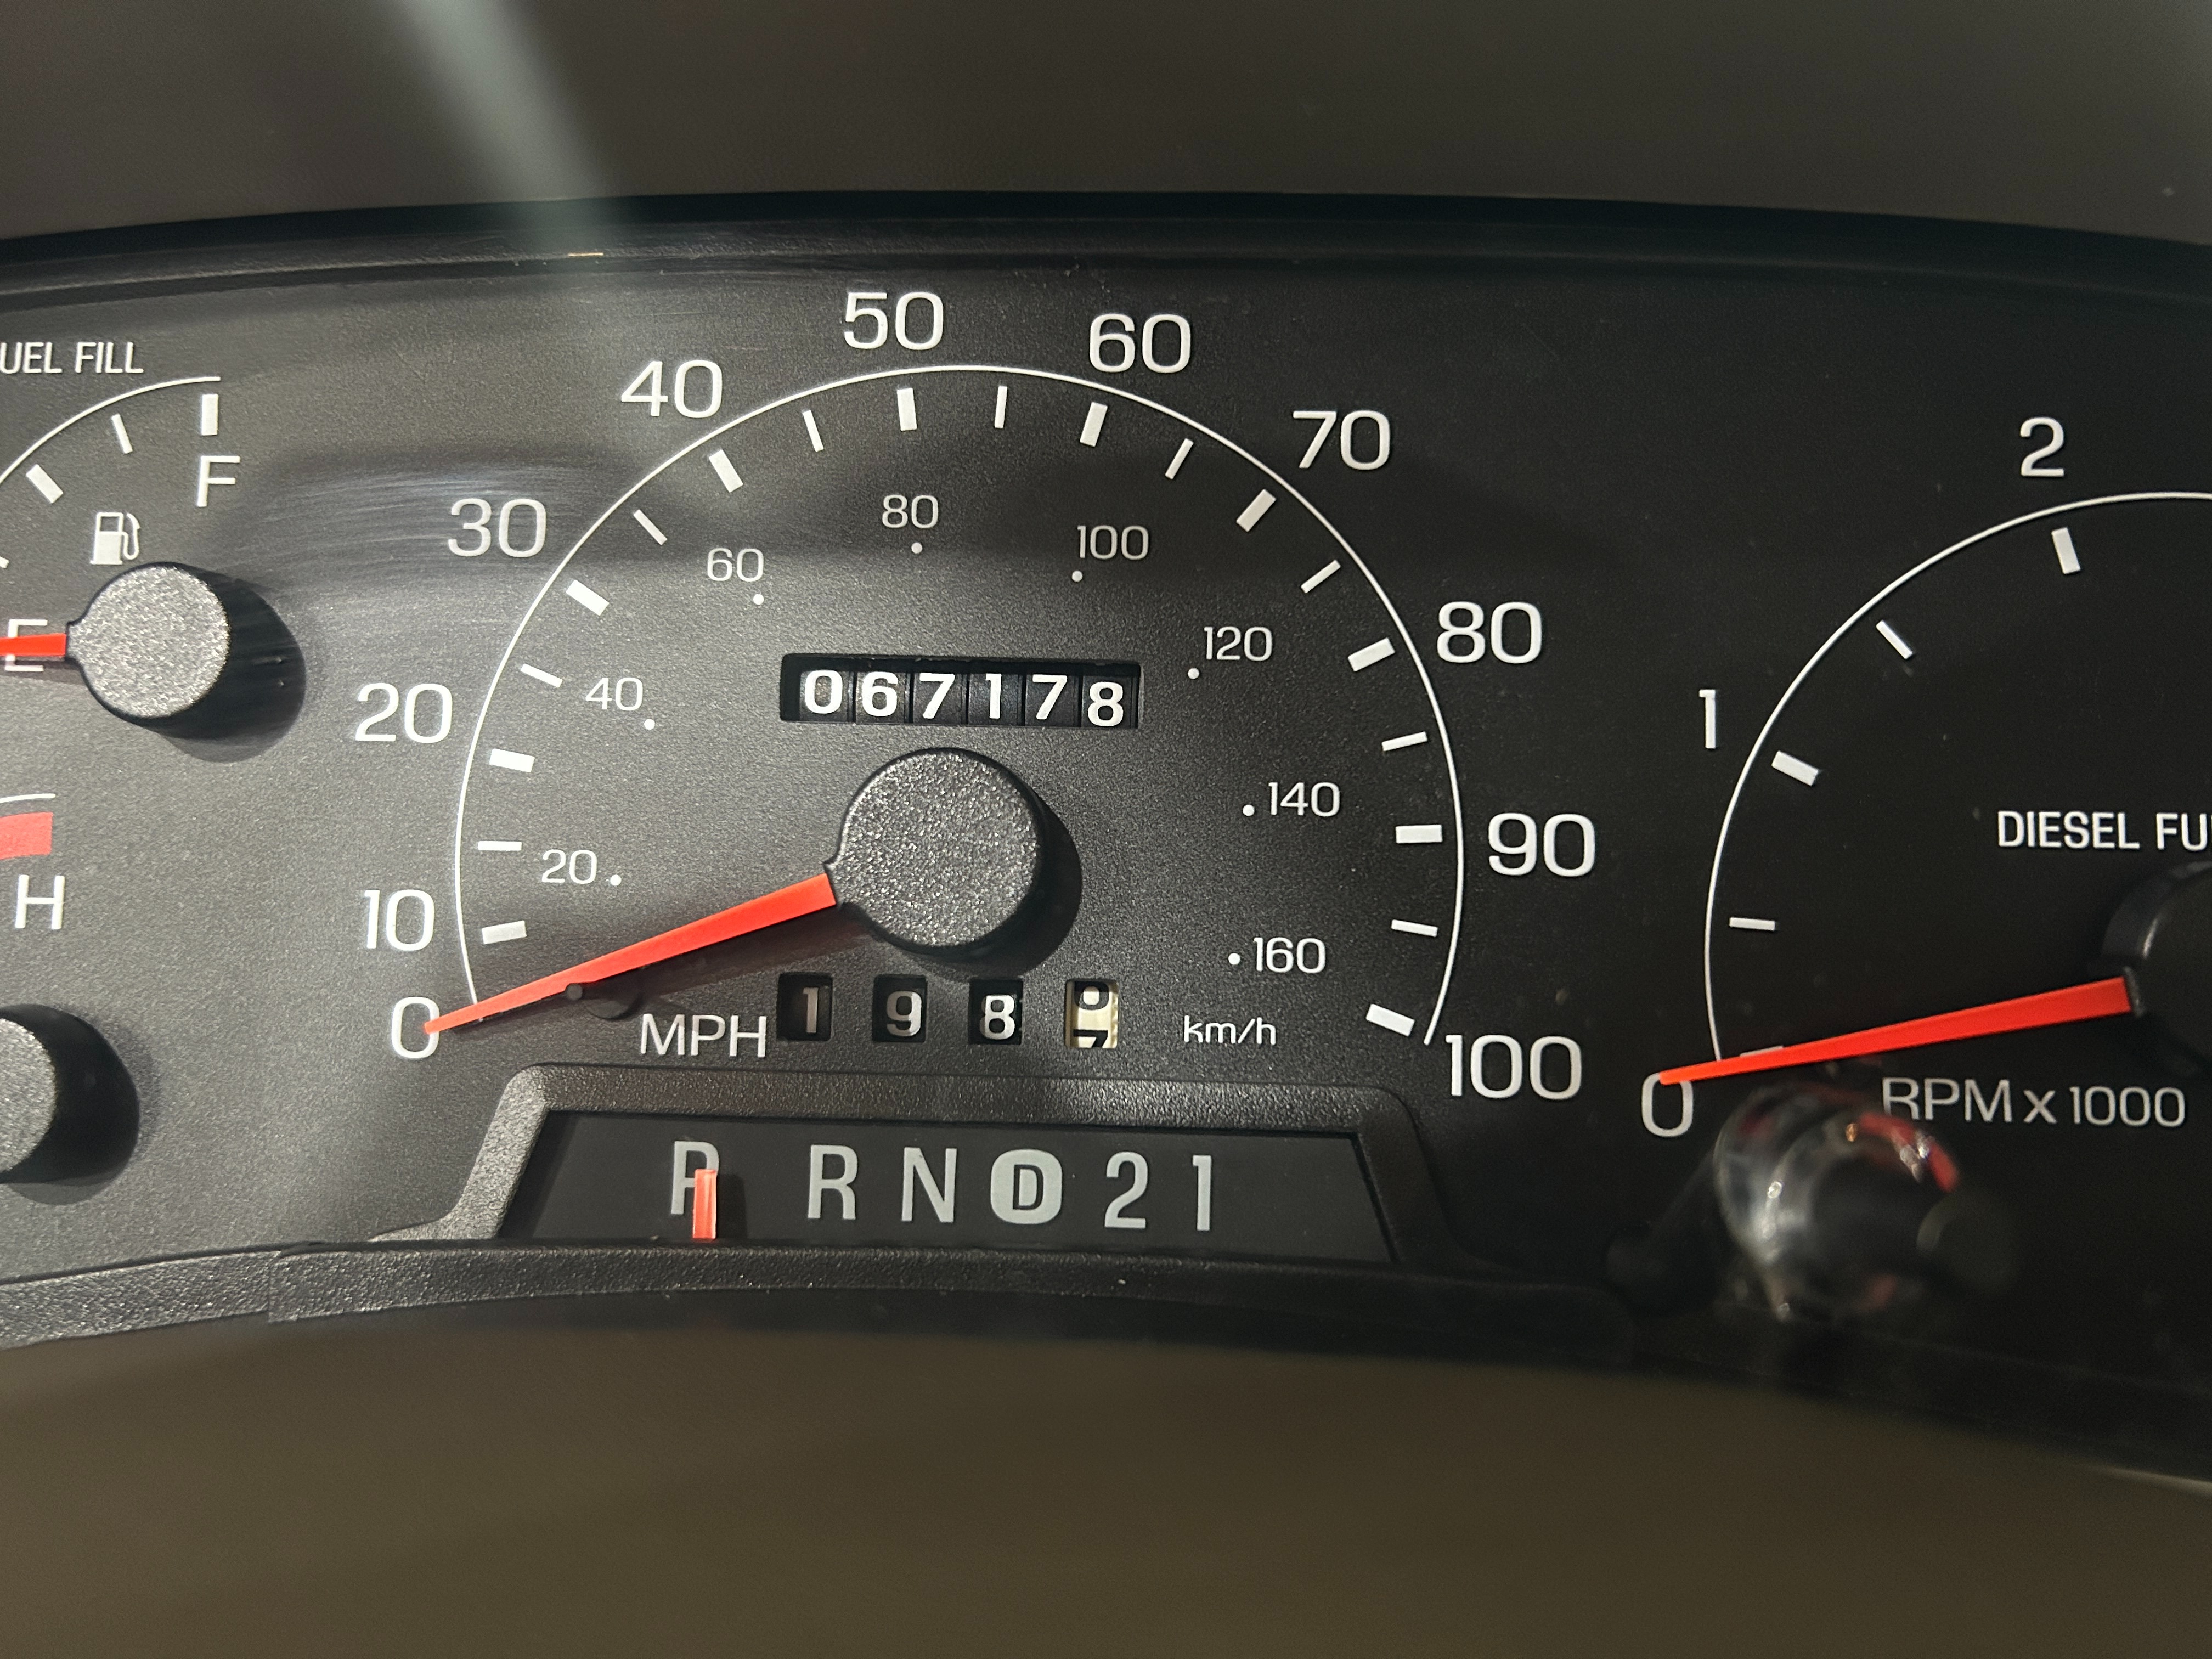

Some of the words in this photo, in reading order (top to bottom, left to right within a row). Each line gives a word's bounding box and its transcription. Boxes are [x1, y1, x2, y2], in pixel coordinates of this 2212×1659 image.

[843, 291, 944, 350] 50
[1089, 313, 1191, 373] 60
[74, 341, 144, 373] FILL
[620, 359, 723, 418] 40
[1293, 409, 1390, 470] 70
[2020, 417, 2064, 476] 2
[195, 454, 240, 507] F
[447, 497, 546, 557] 30
[882, 494, 939, 529] 80
[706, 548, 764, 583] 60
[1077, 524, 1149, 560] 100
[1204, 626, 1272, 661] 120
[1437, 601, 1542, 664] 80
[353, 682, 453, 744] 20
[584, 676, 643, 712] 40
[1699, 689, 1716, 749] 1
[1268, 782, 1340, 817] 140
[1488, 812, 1595, 877] 90
[1998, 810, 2140, 849] DIESEL
[2156, 812, 2212, 851] FU
[540, 849, 597, 884] 20
[14, 874, 65, 930] H
[363, 889, 435, 952] 10
[1254, 936, 1325, 974] 160
[389, 996, 439, 1059] 0
[640, 1013, 767, 1058] MPH
[1184, 1015, 1276, 1045] km/h
[1445, 1034, 1582, 1099] 100
[1641, 1073, 1694, 1137] 0
[1882, 1077, 2012, 1122] RPM
[2024, 1090, 2057, 1124] x
[2069, 1086, 2185, 1127] 1000
[807, 1144, 857, 1220] R
[901, 1147, 957, 1223] N
[1104, 1152, 1148, 1229] 2
[1192, 1155, 1212, 1231] 1
